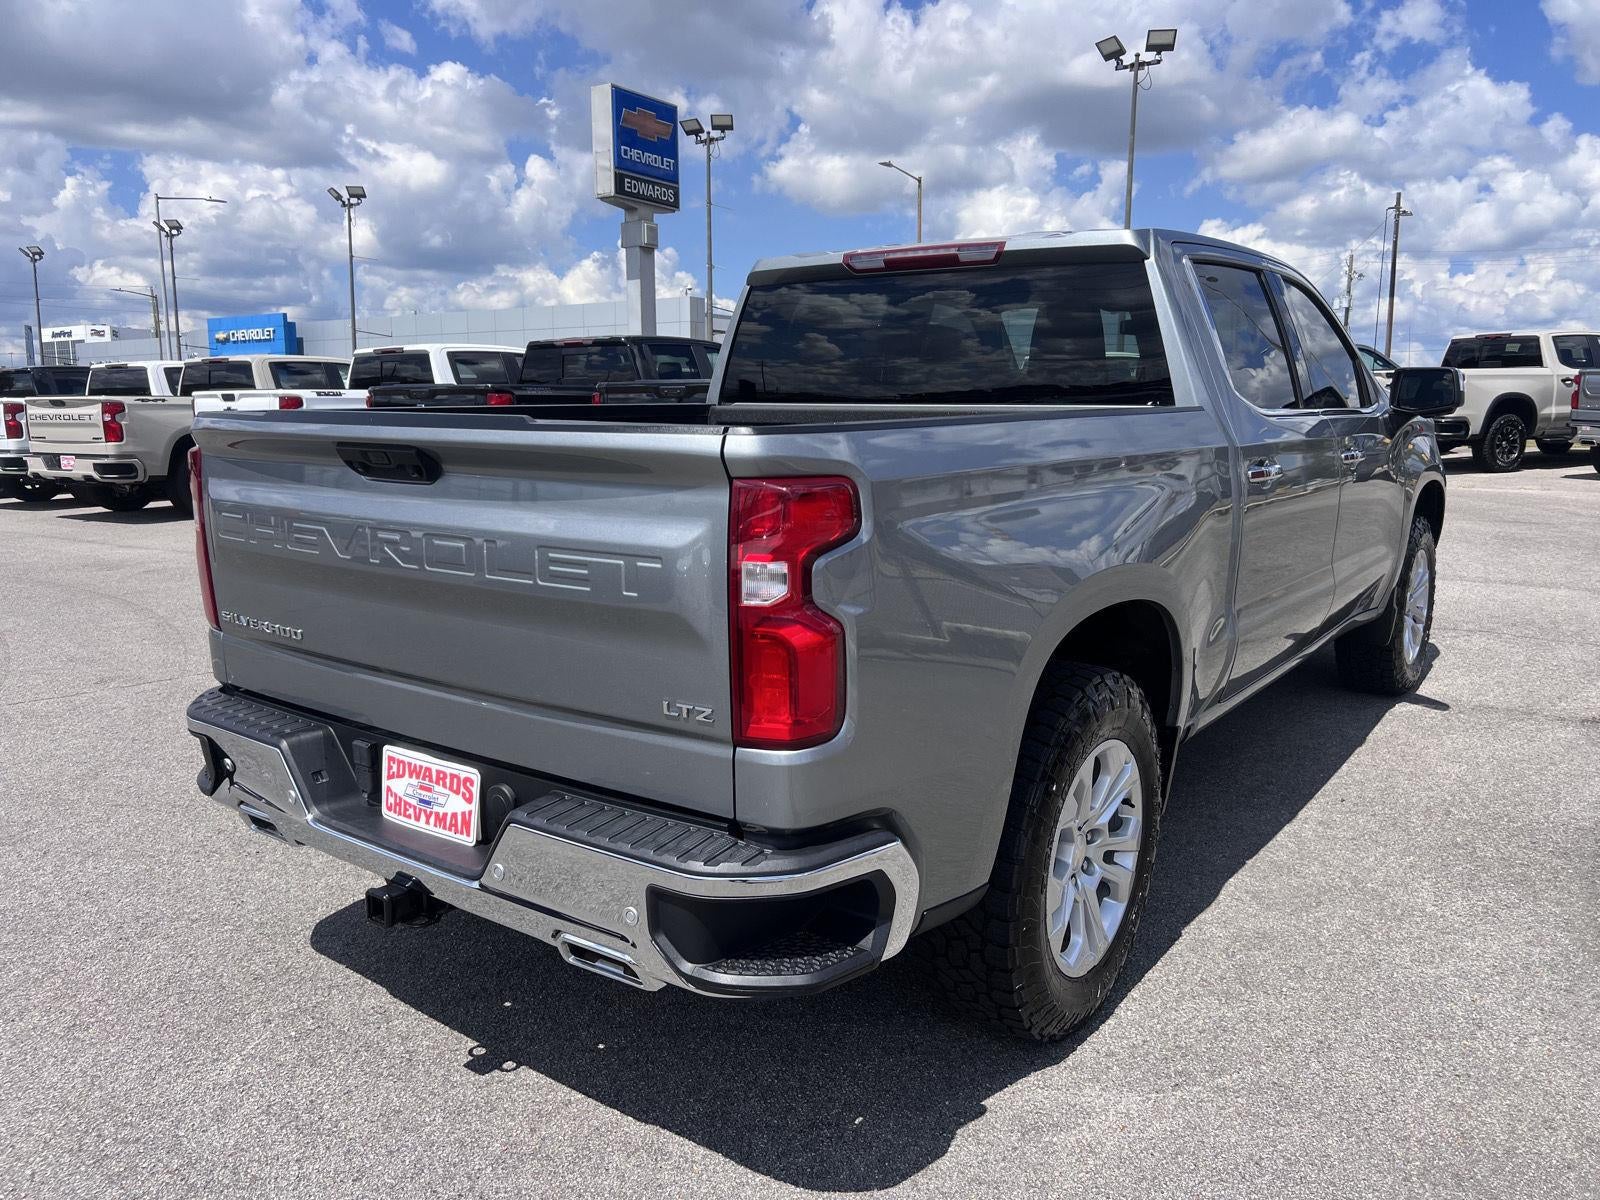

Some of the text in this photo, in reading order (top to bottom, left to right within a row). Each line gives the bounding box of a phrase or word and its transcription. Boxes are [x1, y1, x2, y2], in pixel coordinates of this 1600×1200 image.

[621, 145, 675, 171] CHEVROLET
[624, 178, 675, 202] EDWARDS
[51, 329, 73, 339] AmFirst
[229, 327, 275, 341] CHEVROLET
[216, 511, 663, 597] CHEVROLET
[221, 610, 304, 641] SILVERADO
[662, 700, 715, 723] LTZ
[386, 754, 475, 806] EDWARDS
[385, 784, 473, 838] CHEVYMAN
